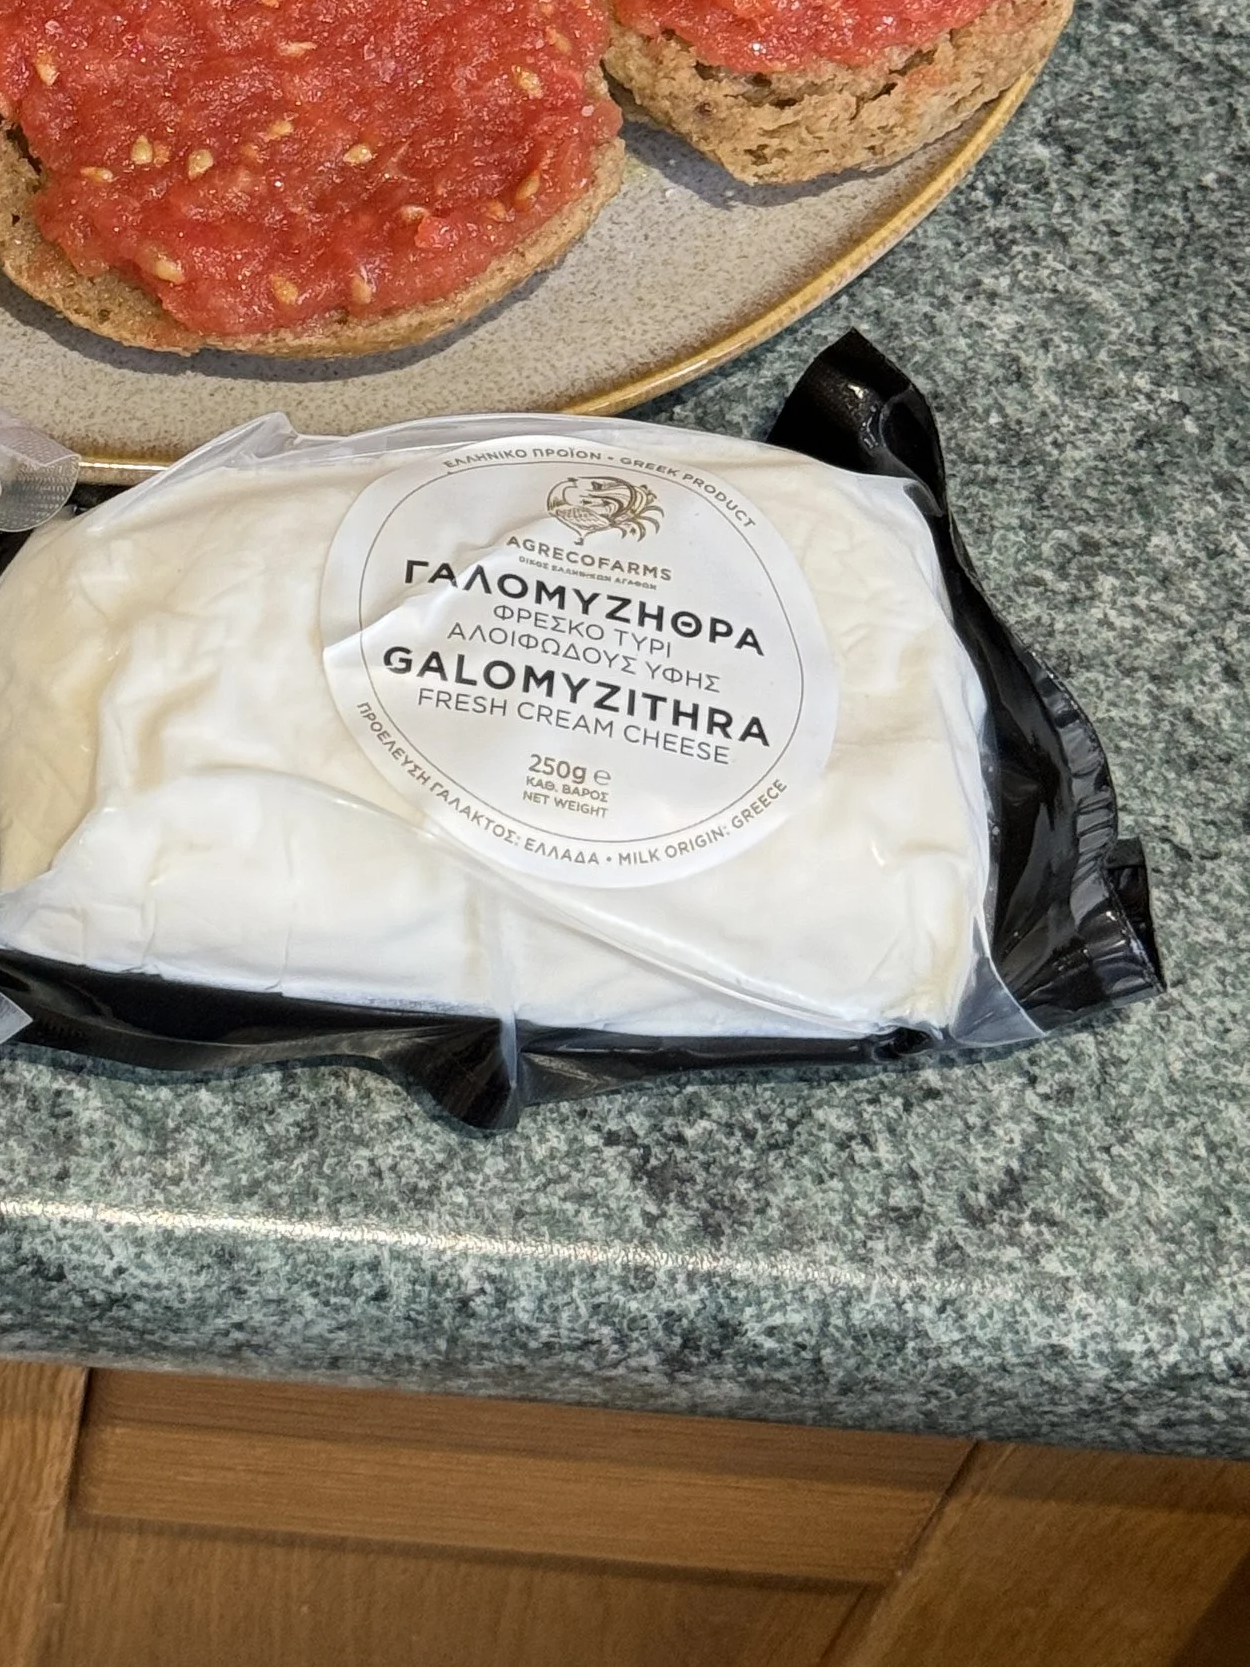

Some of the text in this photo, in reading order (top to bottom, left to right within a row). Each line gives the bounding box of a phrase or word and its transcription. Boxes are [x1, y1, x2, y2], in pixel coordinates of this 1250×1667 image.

[443, 448, 528, 469] ΕΛΛΗΝΙΚΟ
[620, 456, 757, 529] GREEK PRODUCT
[506, 536, 672, 581] AGRECOFARMS
[403, 558, 765, 657] ΓΑΛΟΜΥΖΗΘΡΑ
[492, 604, 672, 658] ΦΡΕΣΚΟ ΤΥΡΙ
[446, 621, 721, 694] ΑΛΟΙΦΩΔΟΥΣ ΥΦΗΣ
[382, 645, 771, 747] GALOMYZITHRA
[417, 687, 731, 766] FRESH CREAM CHEESE
[356, 701, 600, 866] ΠΡΟΕΛΕΥΣΗ ΓΑΛΑΚΤΟΣ: ΕΛΛΑΔΑ
[523, 791, 609, 818] NET WEIGHT
[528, 753, 587, 785] 250g
[561, 783, 609, 803] ΒΑΡΟΣ
[618, 778, 788, 867] MILK ORIGIN: GREECE
